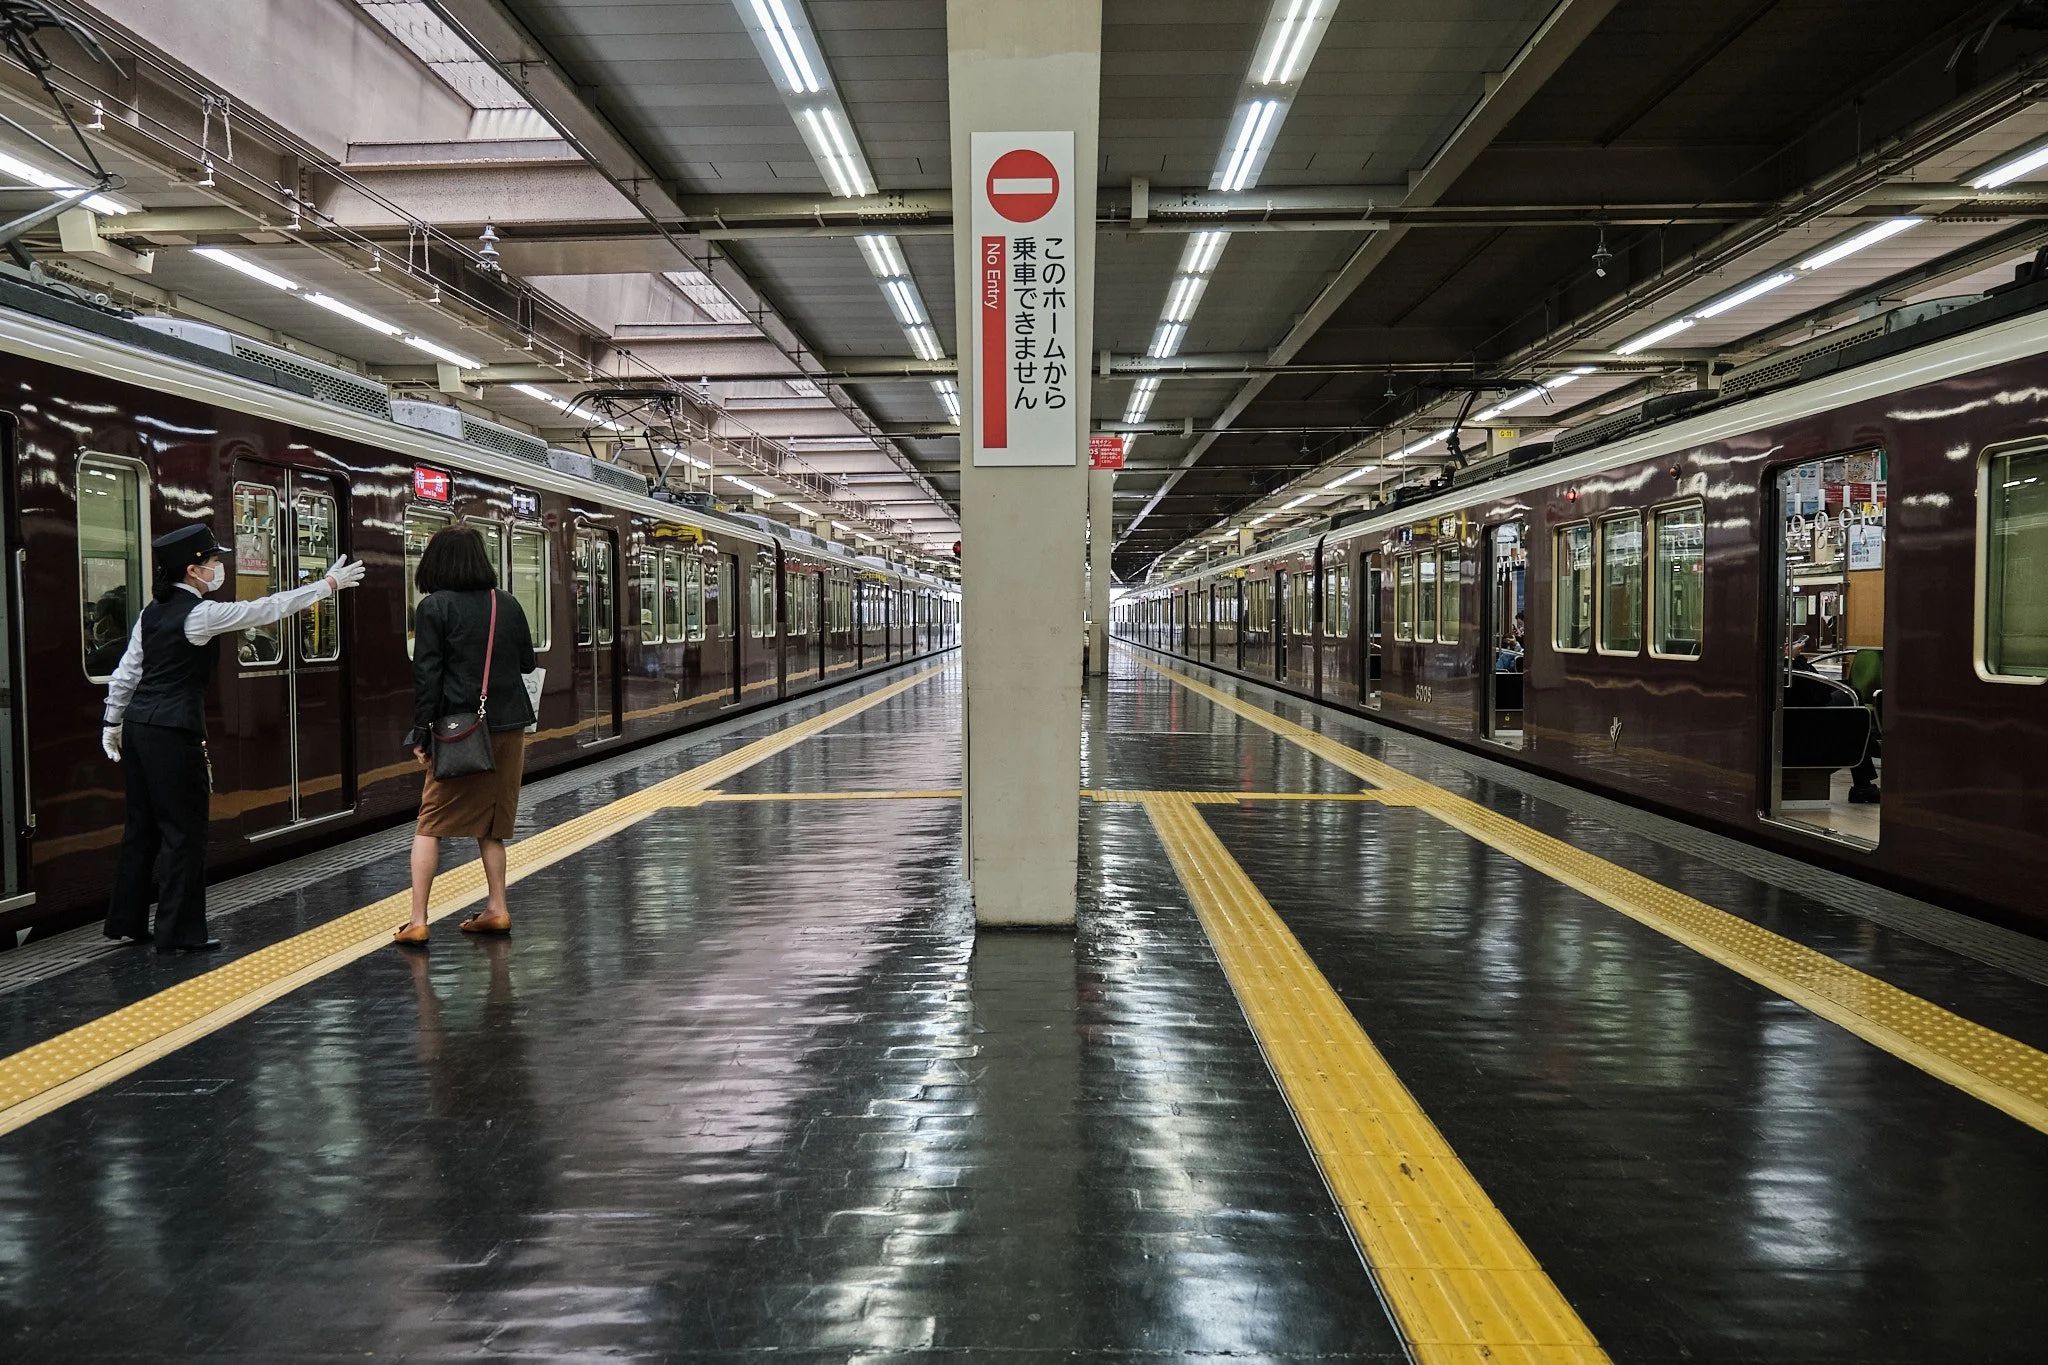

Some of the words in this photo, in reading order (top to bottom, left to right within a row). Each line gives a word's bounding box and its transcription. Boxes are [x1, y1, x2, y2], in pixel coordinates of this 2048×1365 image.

[984, 269, 1001, 310] Entry
[986, 243, 1001, 265] No
[1012, 236, 1038, 409] 乗車できません
[1042, 237, 1067, 409] このホームから
